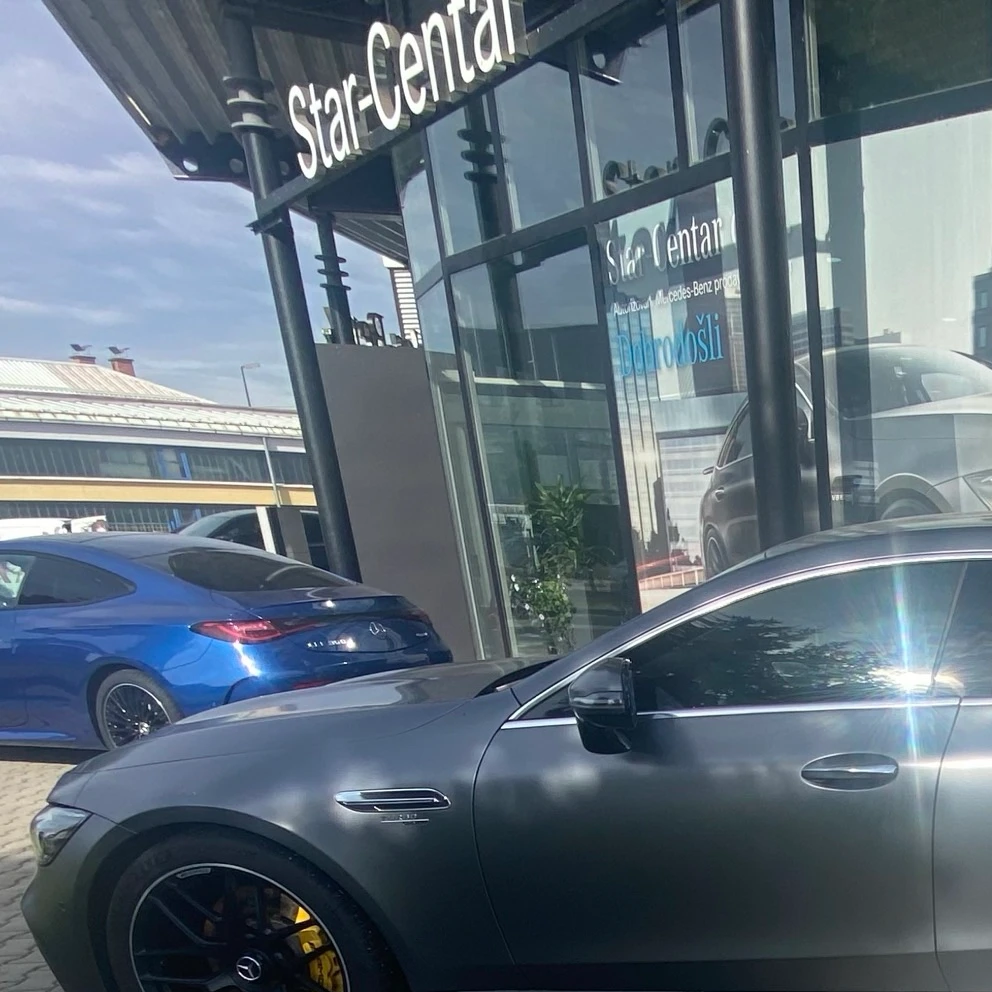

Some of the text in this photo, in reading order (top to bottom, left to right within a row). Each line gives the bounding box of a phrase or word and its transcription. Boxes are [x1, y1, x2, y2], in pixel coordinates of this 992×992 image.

[606, 239, 645, 285] Star
[652, 215, 723, 272] Centar
[655, 281, 712, 306] Mercedes-Benz
[617, 312, 724, 377] Dobrodošli
